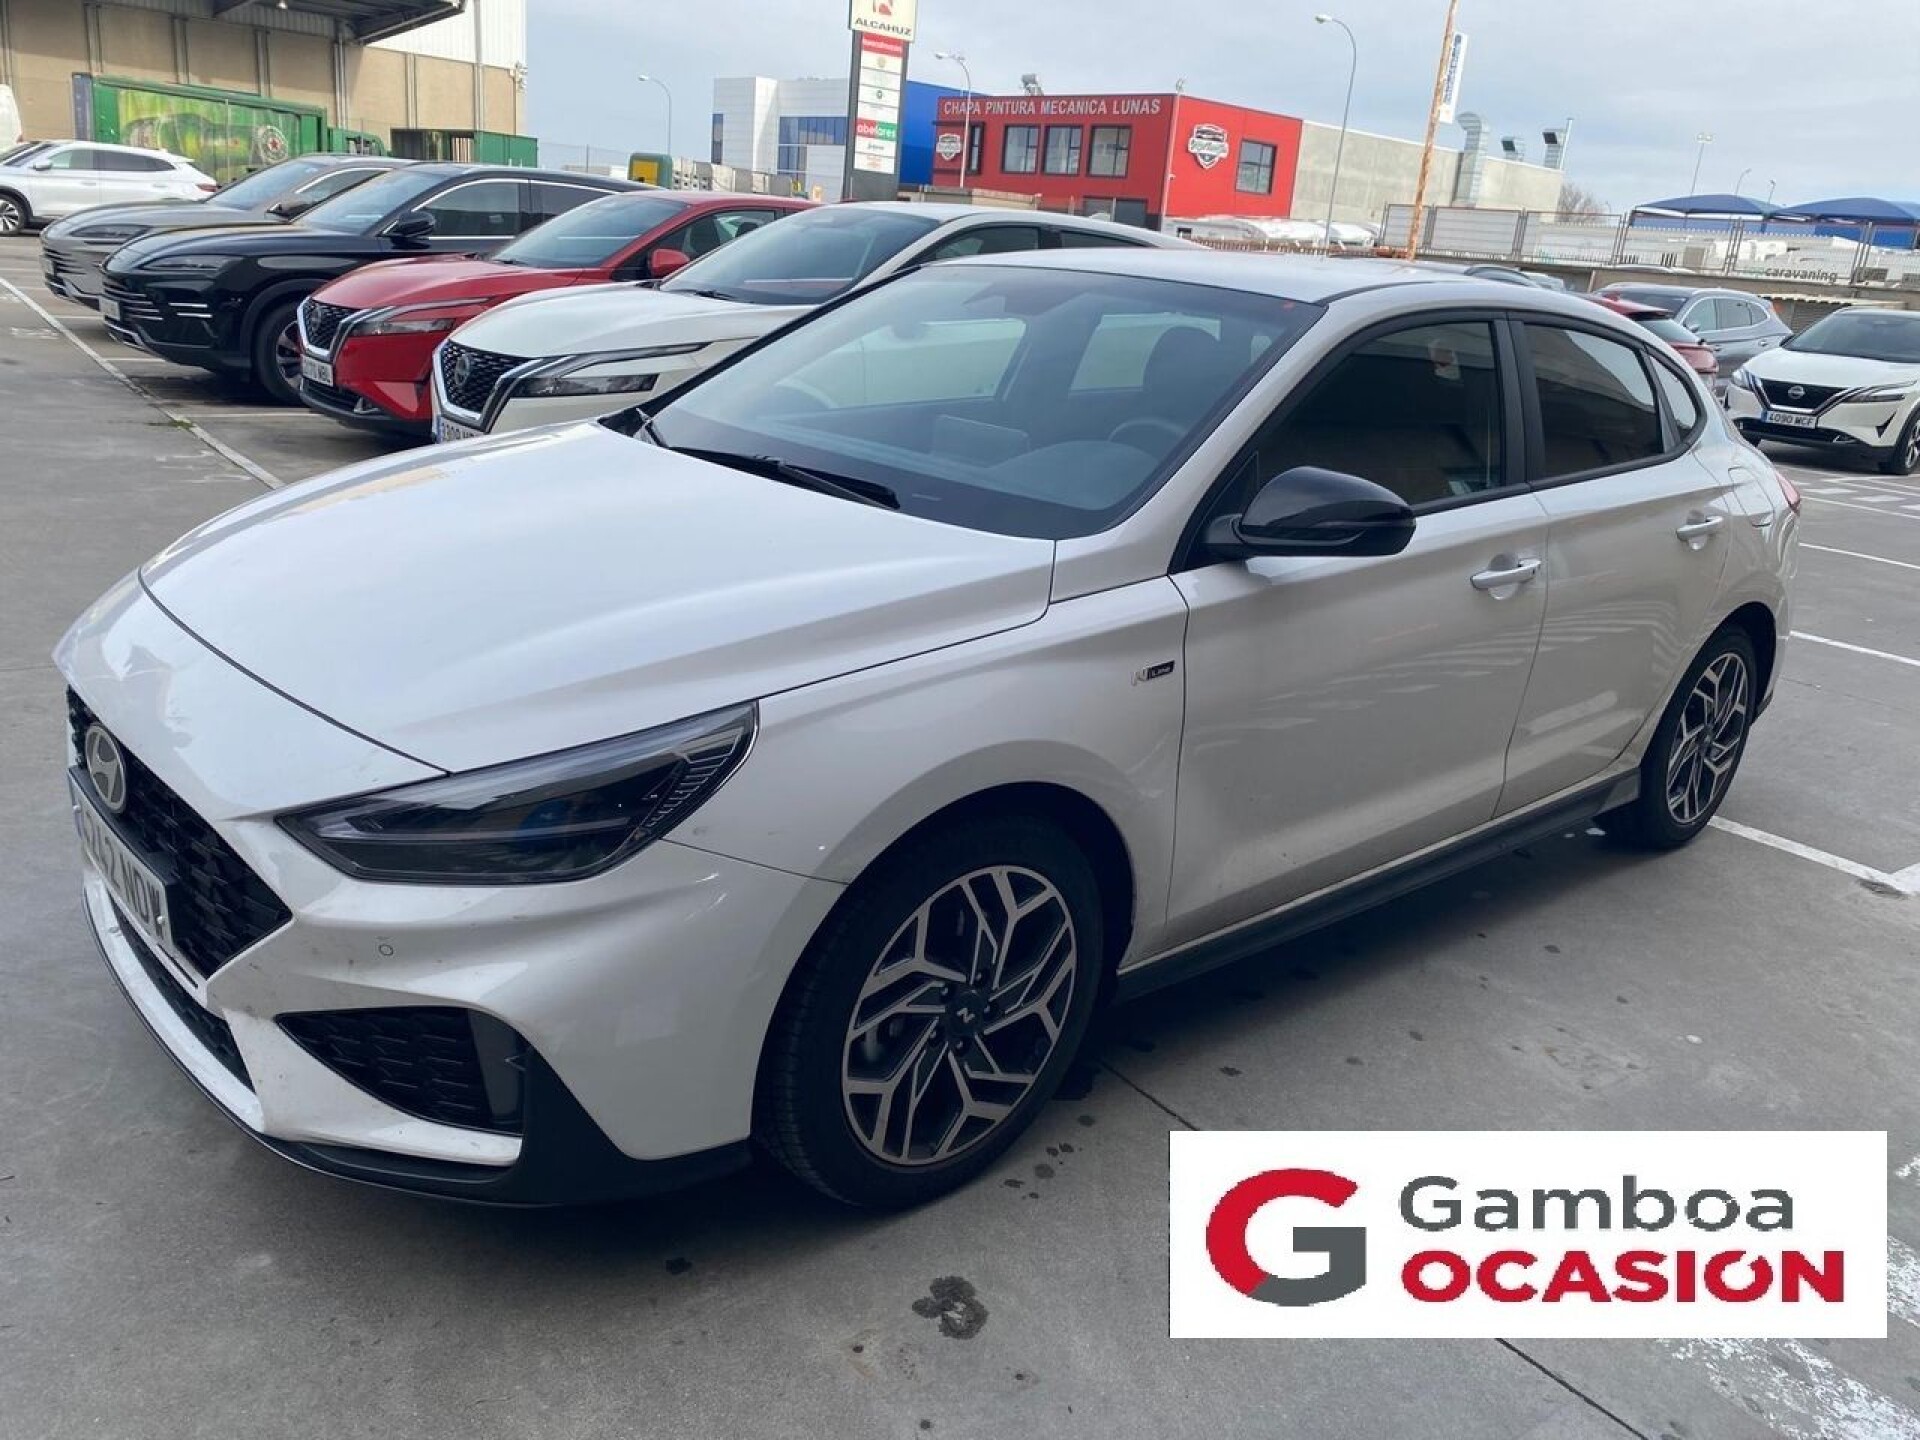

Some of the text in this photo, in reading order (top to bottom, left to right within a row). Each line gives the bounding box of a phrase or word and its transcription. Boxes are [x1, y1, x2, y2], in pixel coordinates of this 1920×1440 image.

[855, 17, 912, 37] ALCAHUZ
[944, 98, 1161, 115] CHAPA PINTURA MECANICA LUNAS
[1765, 267, 1839, 284] caravaning
